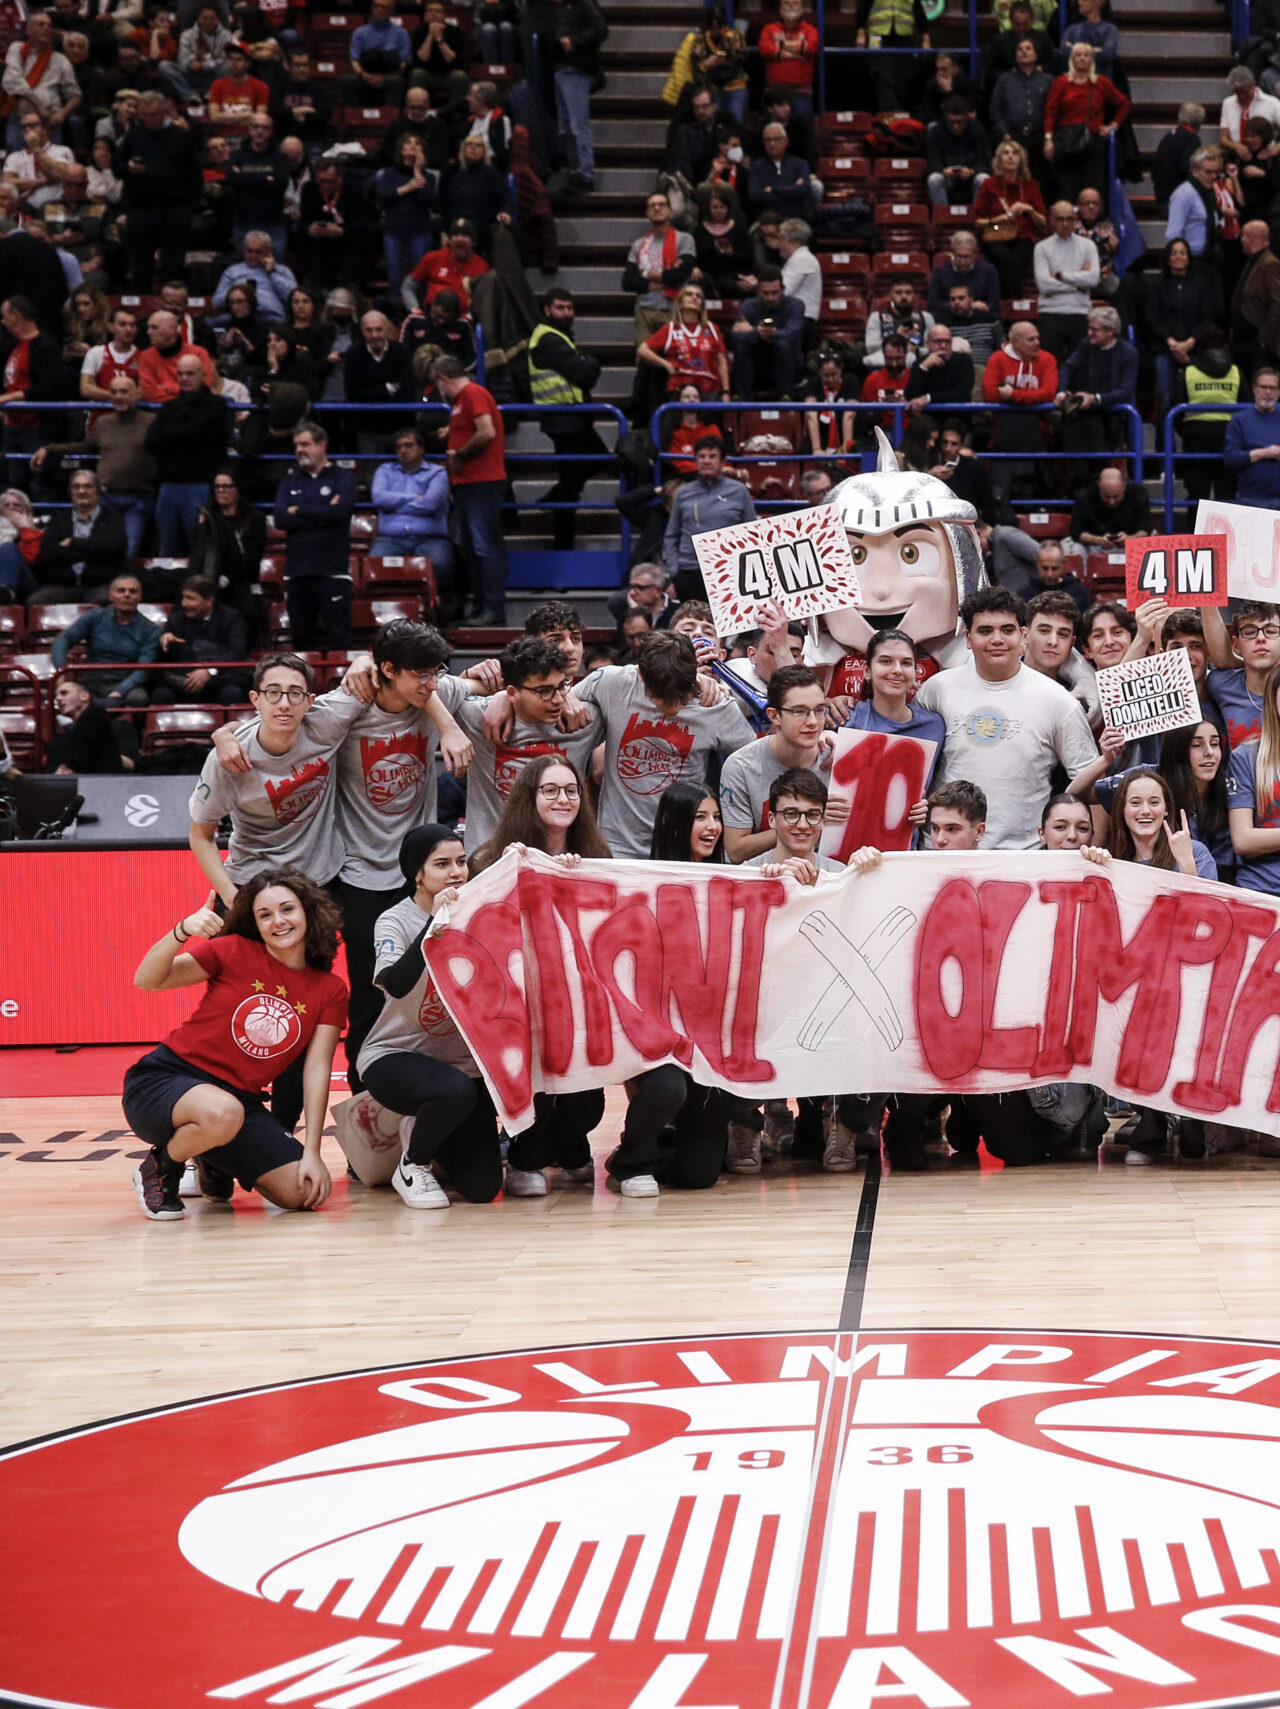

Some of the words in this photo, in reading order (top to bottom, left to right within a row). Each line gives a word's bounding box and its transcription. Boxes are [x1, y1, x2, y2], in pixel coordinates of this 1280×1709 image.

[1121, 674, 1164, 703] LICEO
[1110, 690, 1186, 728] DONATELLI
[833, 733, 925, 857] 10
[259, 997, 294, 1020] OLIMPIA
[237, 1036, 269, 1056] MILANO
[684, 1449, 786, 1471] 19
[866, 1445, 974, 1466] 36
